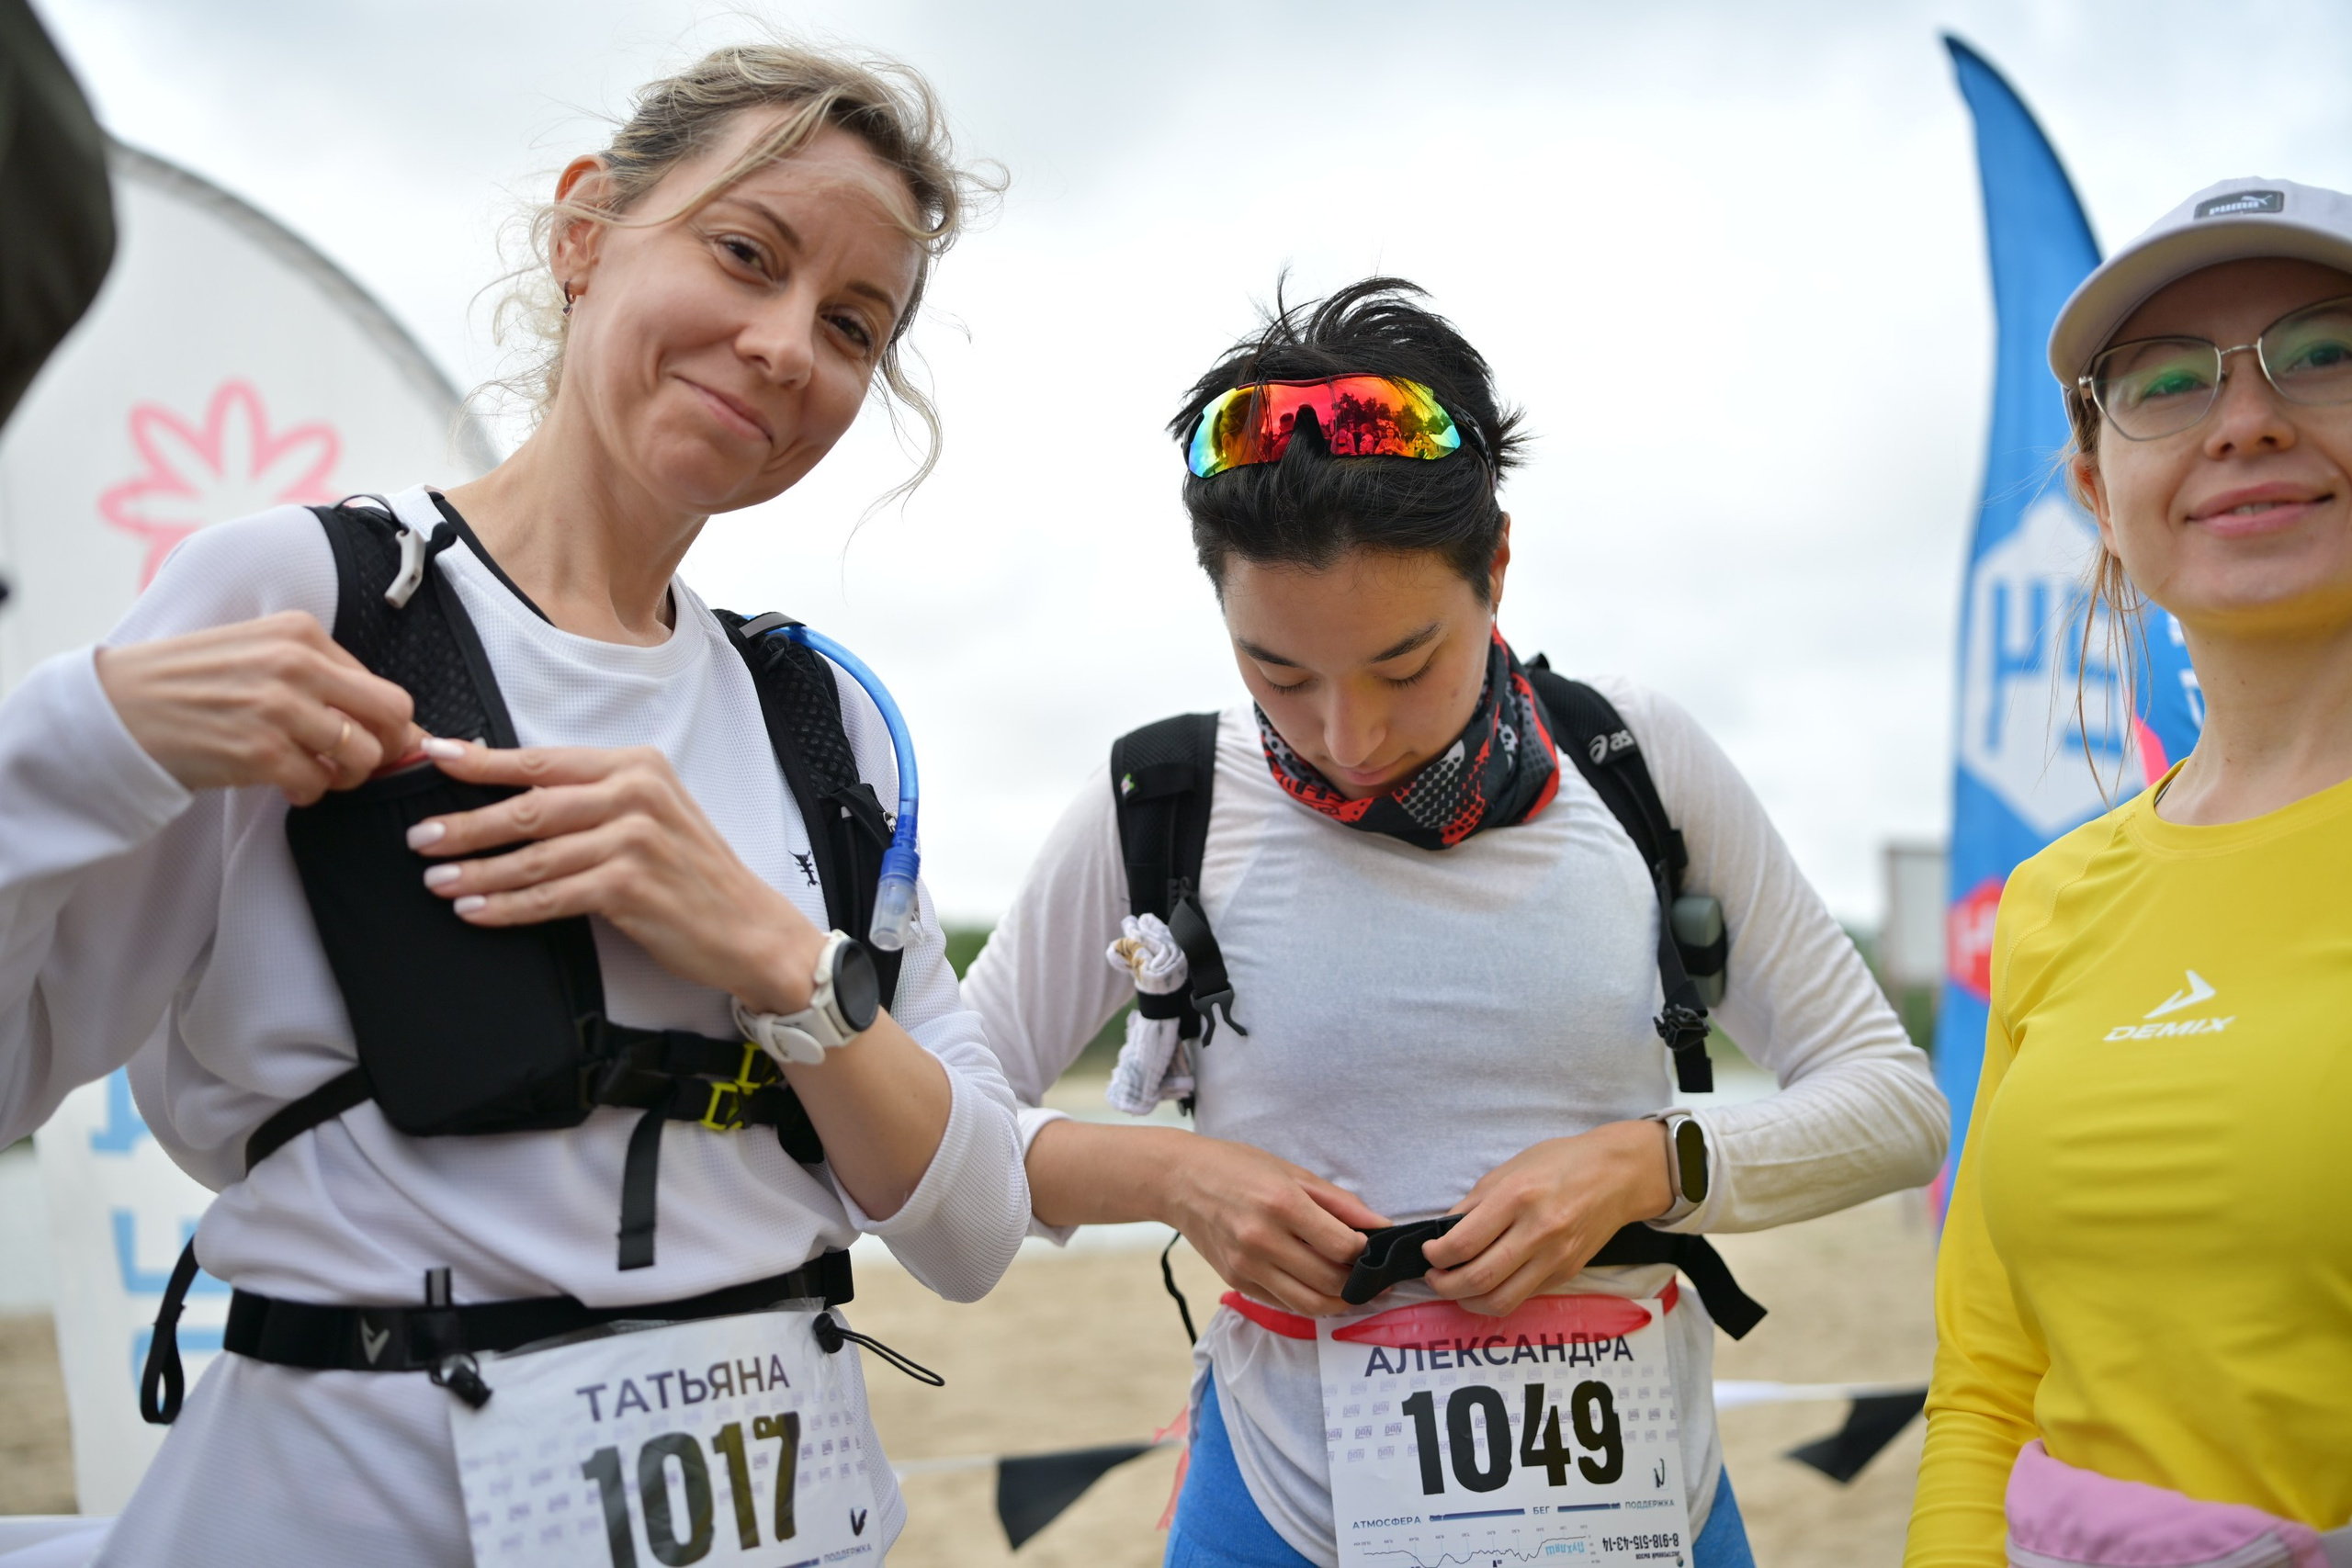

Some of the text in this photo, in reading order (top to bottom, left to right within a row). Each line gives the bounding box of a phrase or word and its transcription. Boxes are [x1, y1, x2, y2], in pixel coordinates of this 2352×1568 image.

[2103, 1015, 2237, 1042] DEMIX
[1364, 1333, 1634, 1377] АЛЕКСАНДРА
[576, 1354, 790, 1422] ТАТЬЯНА
[1401, 1380, 1624, 1495] 1049
[582, 1411, 800, 1568] 1017
[1352, 1499, 1676, 1530] АТМОСФЕРА БЕГ ПОДДЕРЖКА
[1602, 1533, 1679, 1552] 8-918-515-43-14
